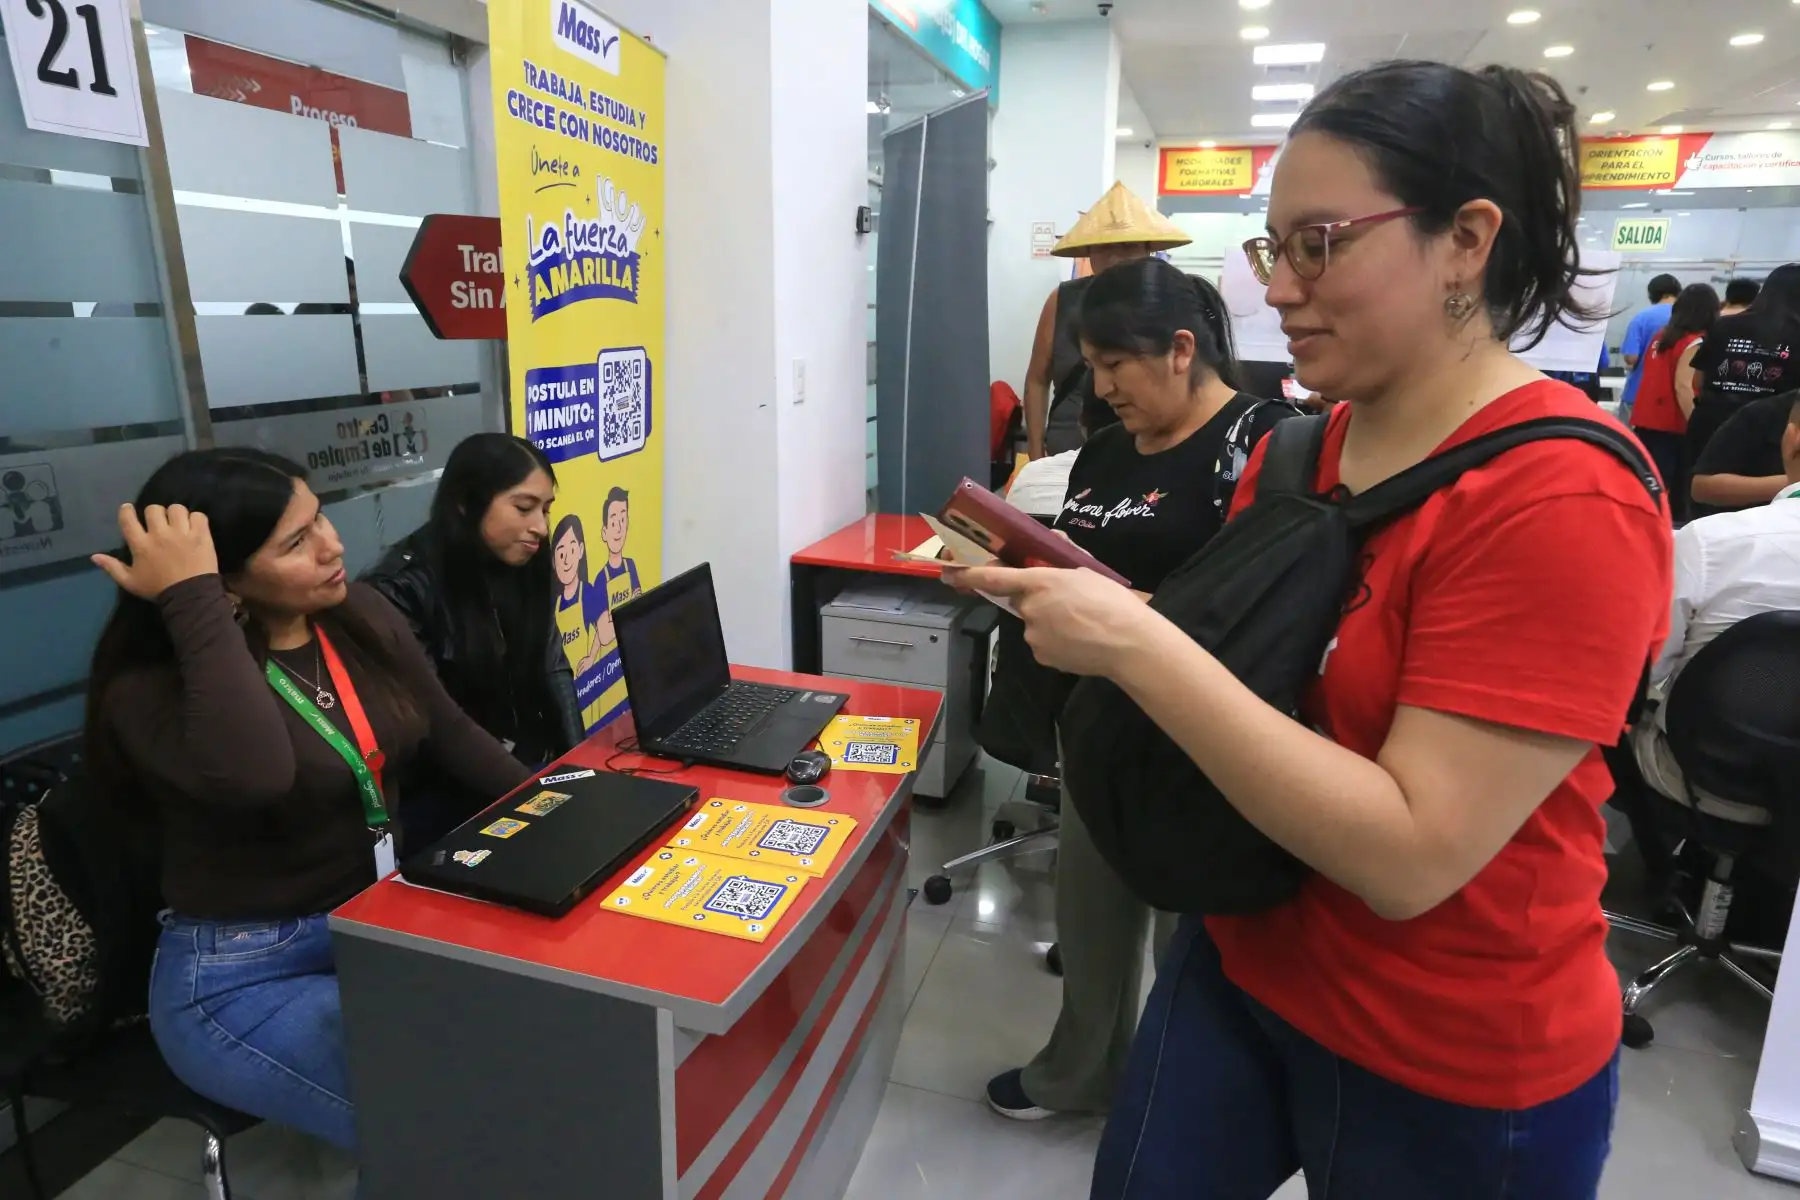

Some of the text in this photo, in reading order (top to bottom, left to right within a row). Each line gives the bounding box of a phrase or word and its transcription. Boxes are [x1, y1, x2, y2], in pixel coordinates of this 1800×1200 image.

[557, 2, 600, 54] Mass
[26, 0, 118, 97] 21
[523, 60, 646, 130] TRABAJA, ESTUDIA Y
[289, 95, 359, 128] Proceso
[507, 90, 658, 165] CRECE CON NOSOTROS
[531, 144, 580, 178] Únete a
[1600, 161, 1645, 170] PARA EL
[1771, 151, 1783, 159] de
[528, 212, 628, 261] La fuerza
[1617, 225, 1663, 245] SALIDA
[450, 280, 494, 309] Sin
[535, 257, 633, 306] AMARILLA
[579, 377, 595, 396] EN
[533, 402, 595, 433] MINUTO:
[546, 432, 575, 449] SCANEA
[576, 431, 583, 442] EL
[585, 428, 595, 443] QR
[1079, 504, 1104, 517] are
[611, 588, 630, 607] Mass
[543, 772, 577, 785] Mass
